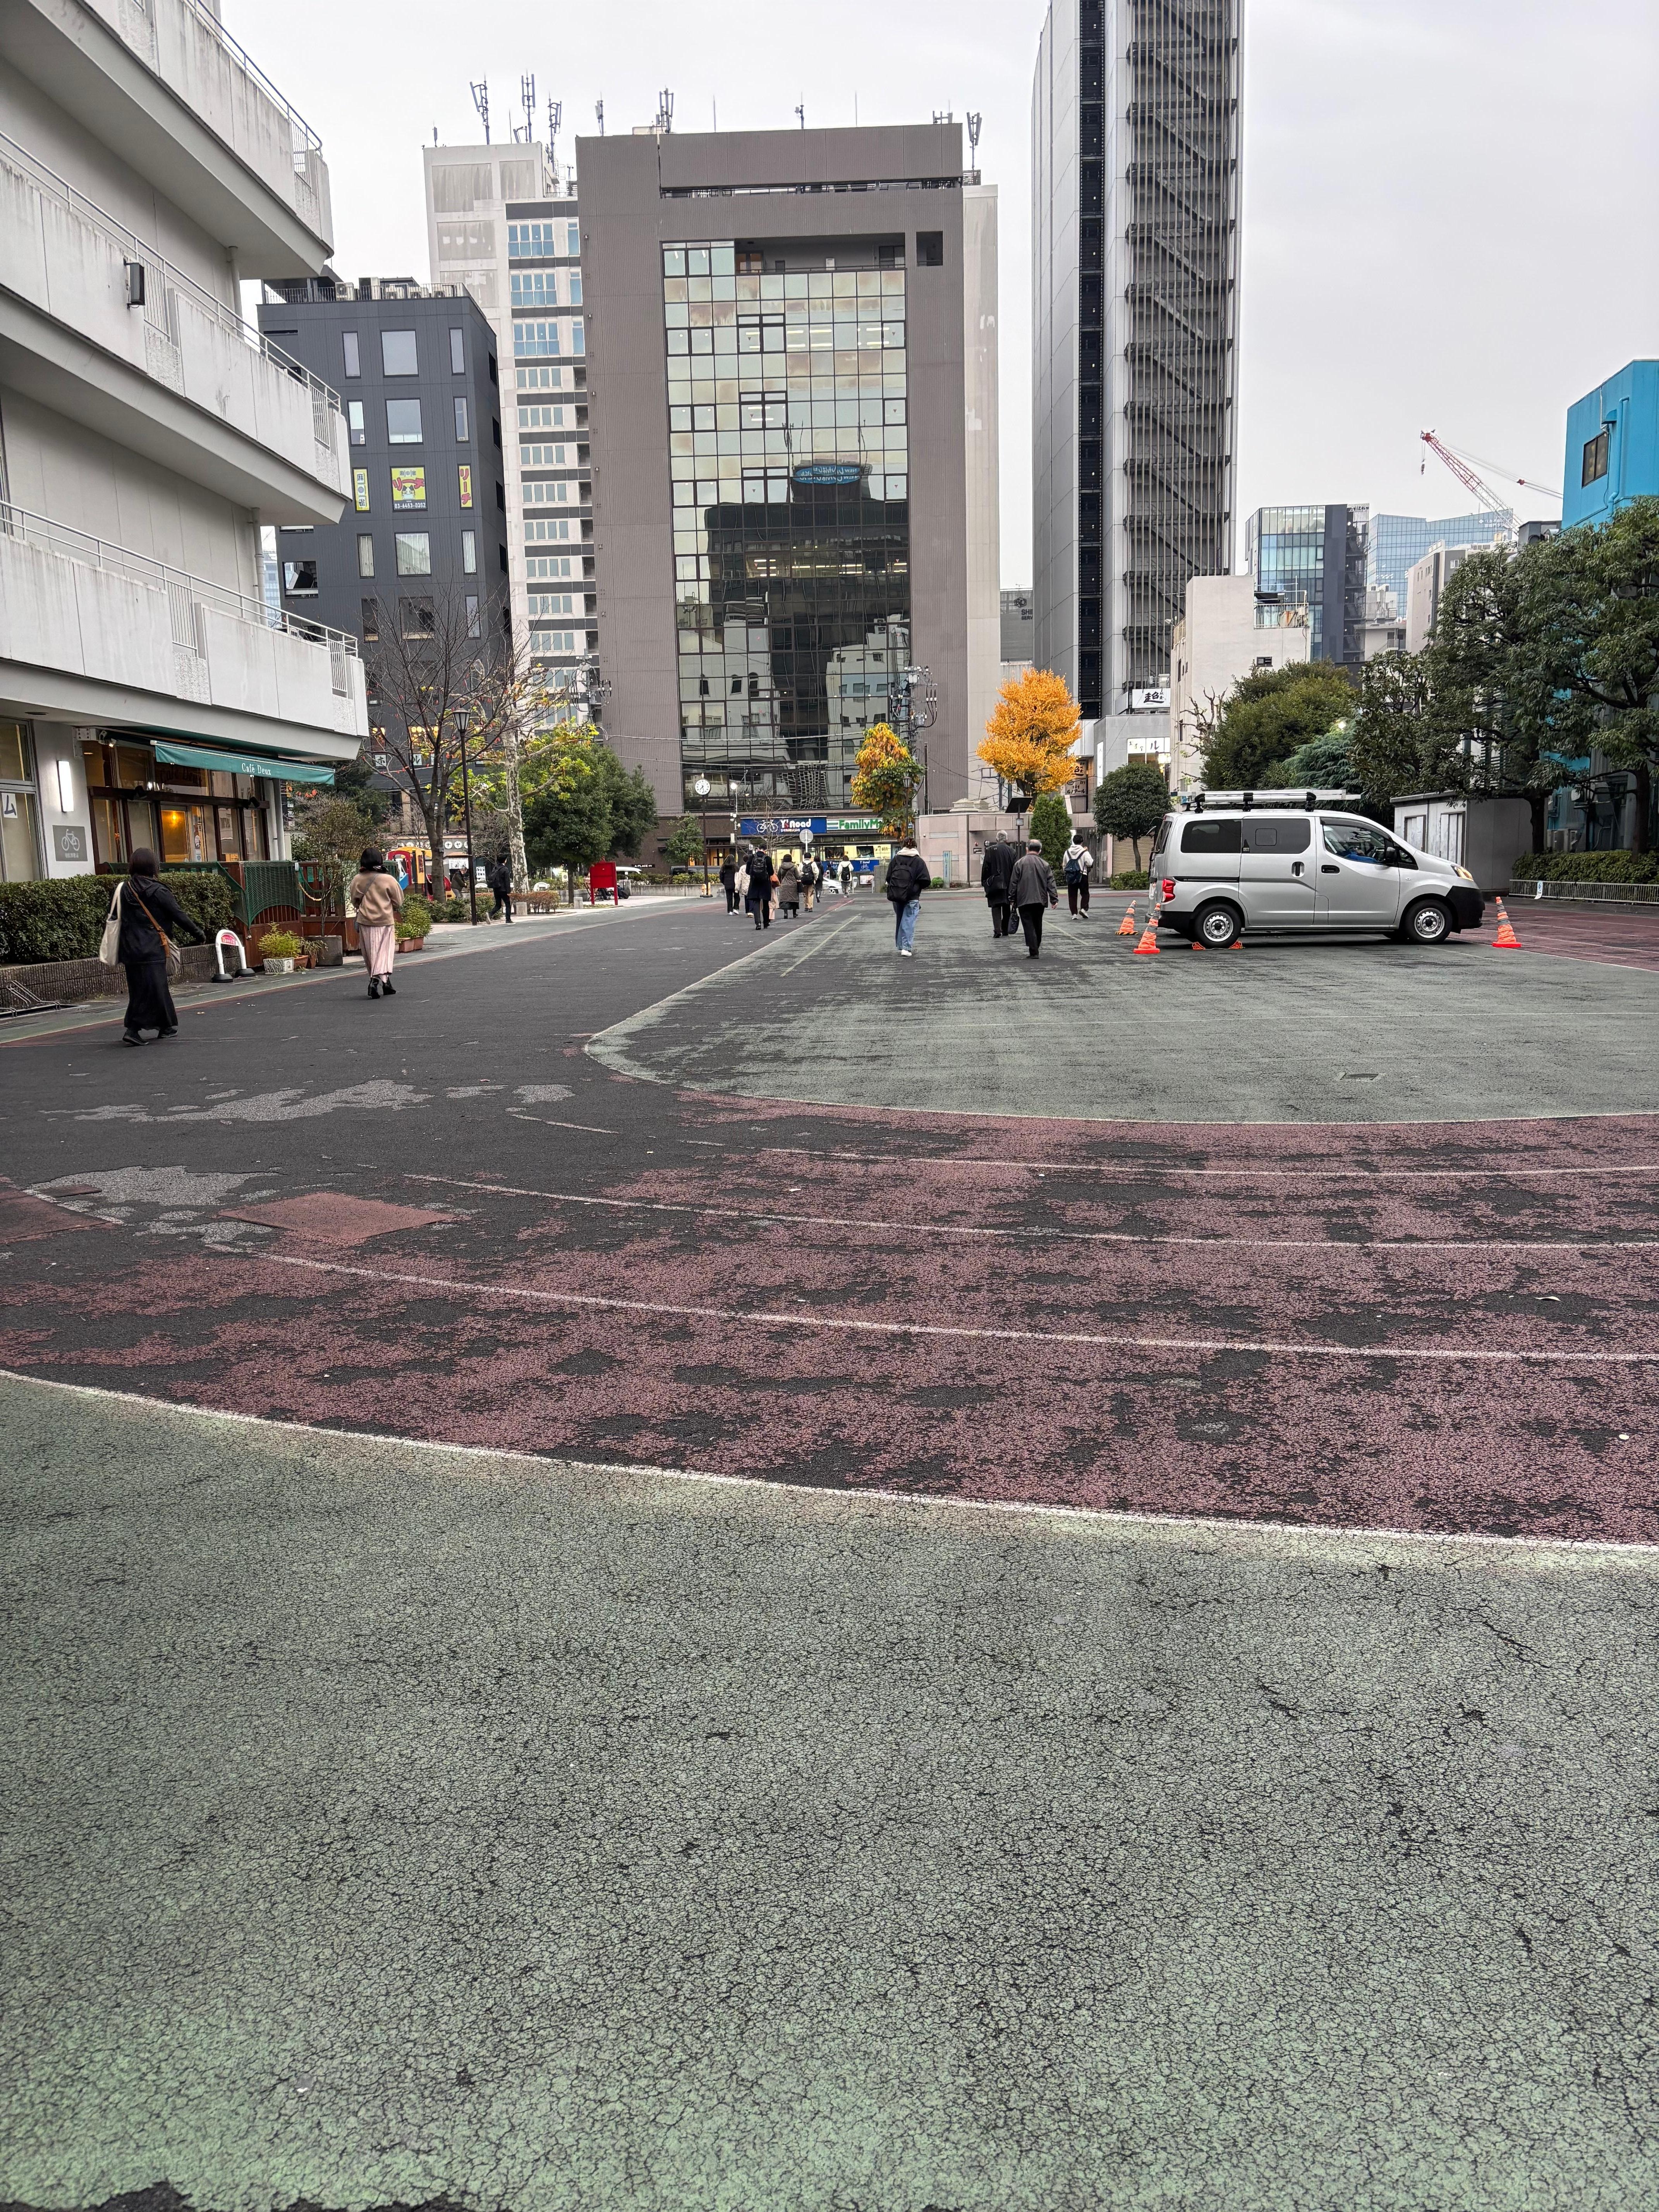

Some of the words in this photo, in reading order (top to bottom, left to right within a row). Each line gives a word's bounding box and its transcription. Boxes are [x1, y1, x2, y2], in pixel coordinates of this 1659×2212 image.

[392, 477, 424, 491] リーチ
[460, 468, 471, 505] リーチ
[1144, 691, 1164, 703] 超
[242, 763, 255, 773] Café
[257, 764, 271, 776] Deux
[839, 819, 879, 830] FamilyM
